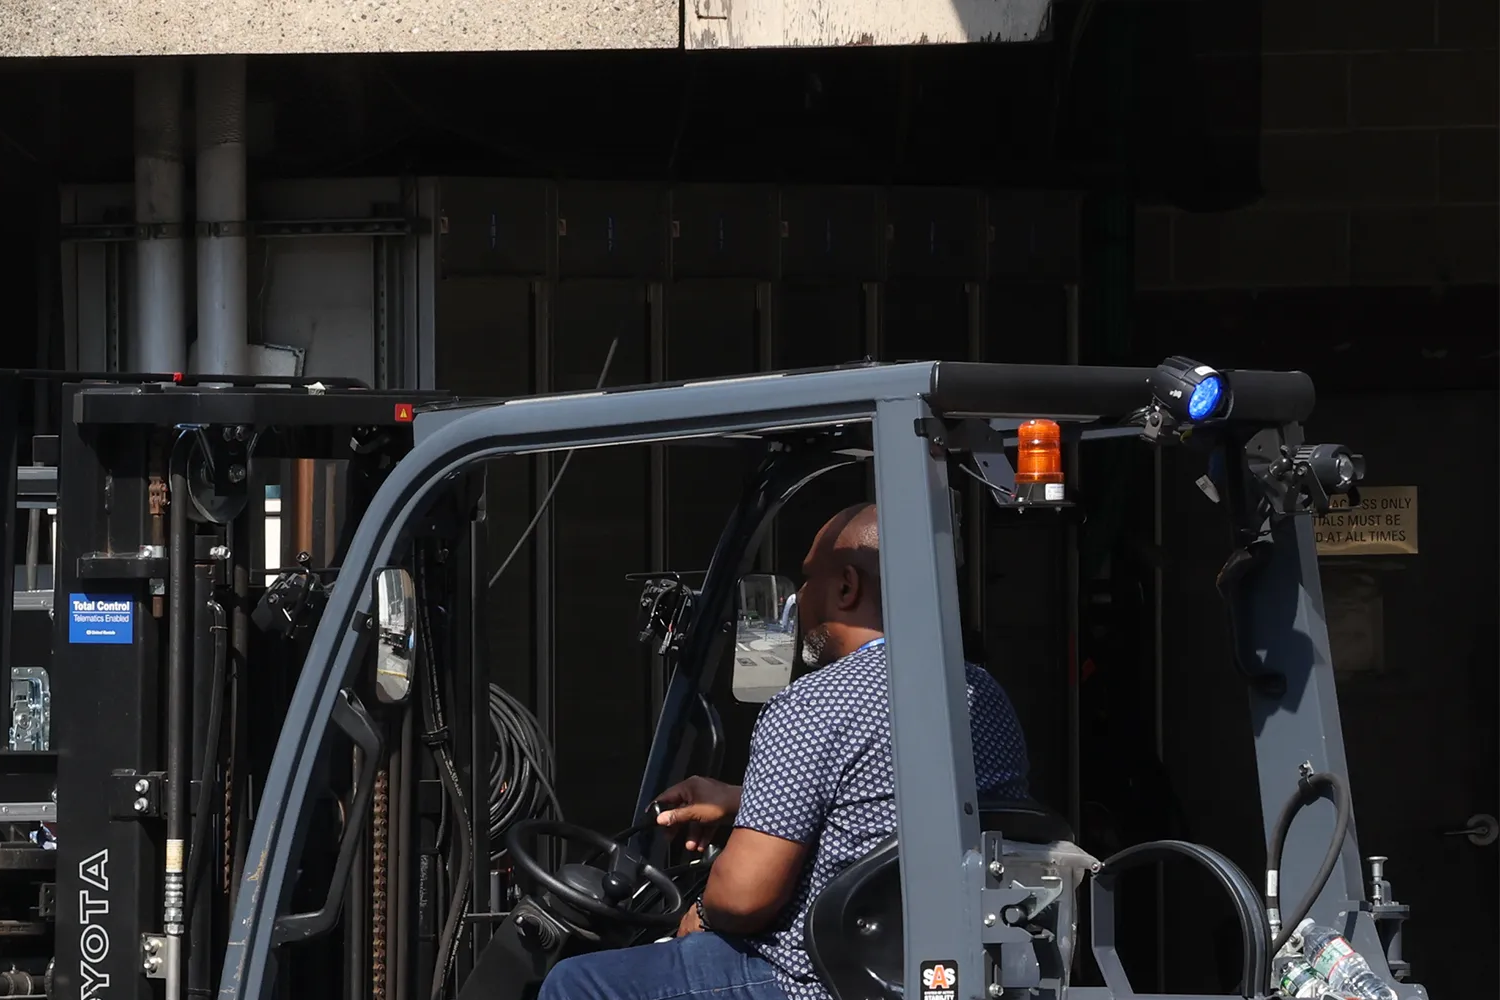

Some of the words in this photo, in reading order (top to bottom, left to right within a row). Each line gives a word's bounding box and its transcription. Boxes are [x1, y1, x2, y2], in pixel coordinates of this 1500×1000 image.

[1331, 499, 1377, 509] ACSS
[1381, 499, 1412, 509] ONLY
[1347, 515, 1381, 526] MUST
[1385, 514, 1400, 526] BE
[1327, 531, 1341, 543] AT
[1345, 531, 1366, 542] ALL
[1368, 530, 1406, 542] TIMES
[73, 601, 95, 611] Total
[97, 601, 130, 611] Control
[74, 614, 104, 623] Telematics
[105, 614, 130, 623] Enabled
[923, 964, 956, 989] SAS
